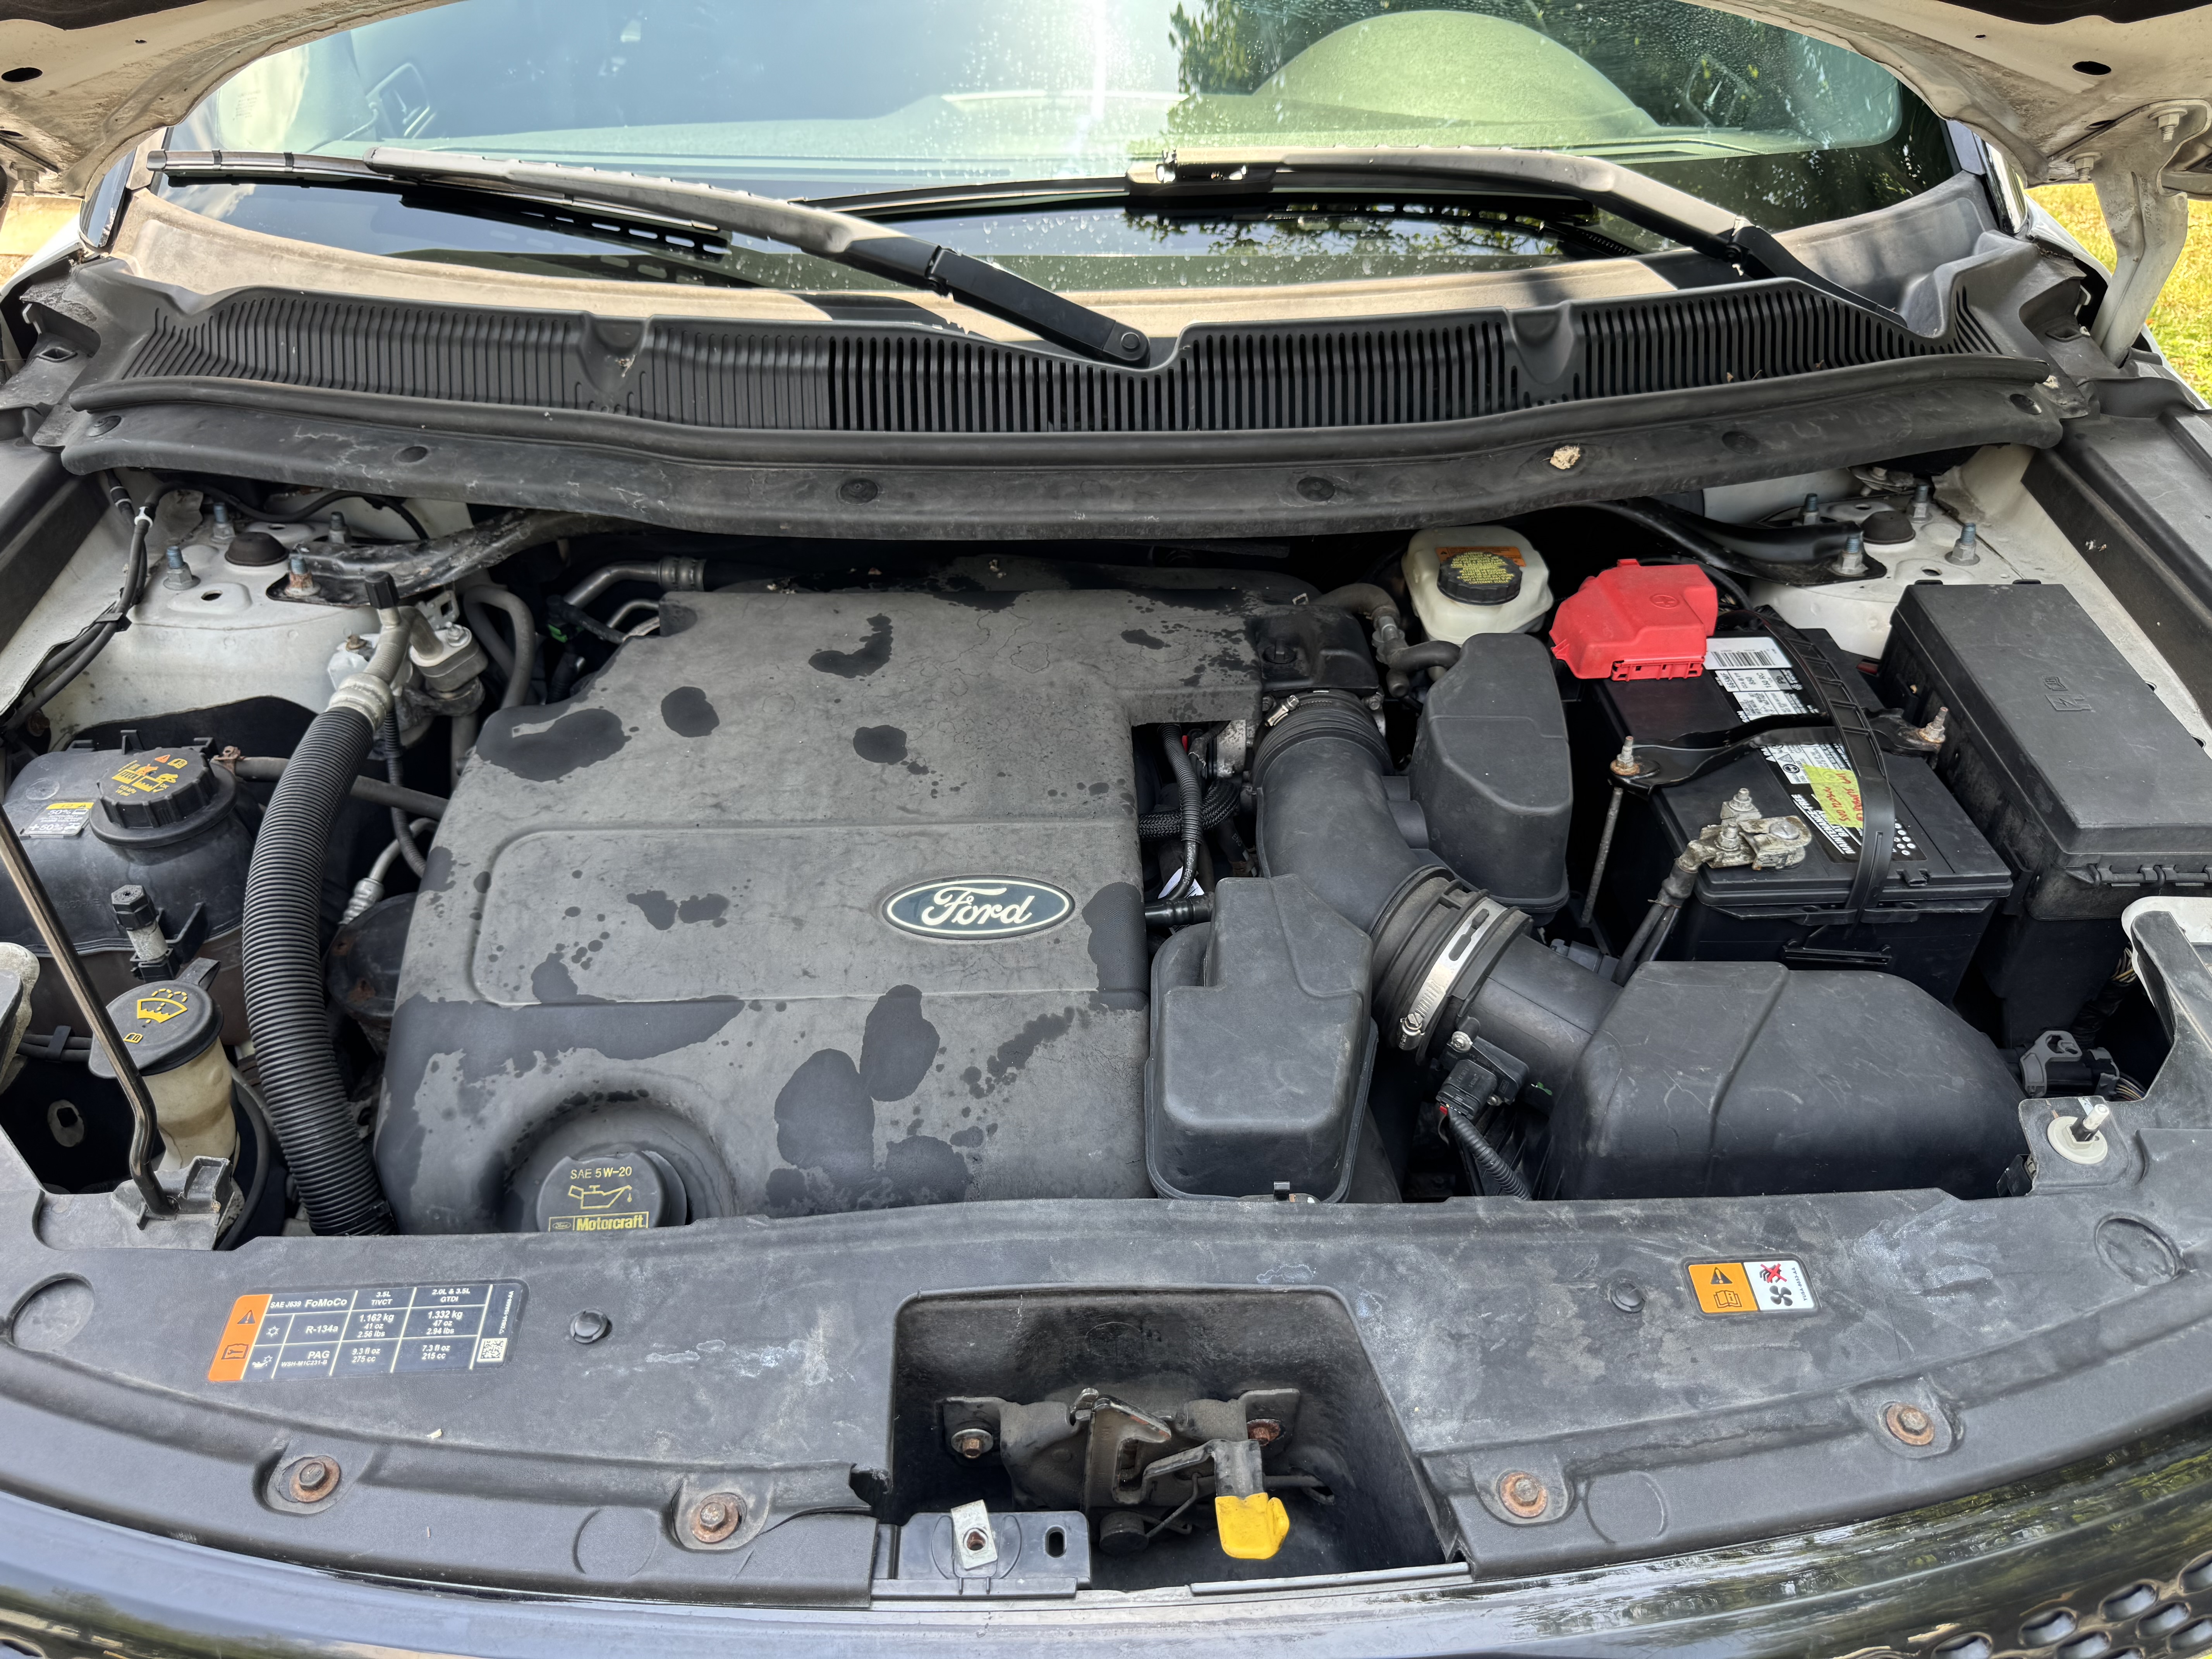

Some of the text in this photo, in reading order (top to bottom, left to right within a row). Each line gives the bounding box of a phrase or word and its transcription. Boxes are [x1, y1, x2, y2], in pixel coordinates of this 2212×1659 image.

[1719, 673, 1736, 688] 665MF
[1736, 711, 1750, 723] SON
[922, 886, 1035, 925] Ford
[570, 1166, 632, 1179] SAE 5W-20
[577, 1215, 644, 1231] Motorcraft
[305, 1298, 347, 1307] FoMoCo
[359, 1313, 394, 1323] 1.162 kg
[428, 1310, 463, 1320] 1.332 kg
[306, 1325, 338, 1334] R-134a
[307, 1350, 330, 1359] PAG
